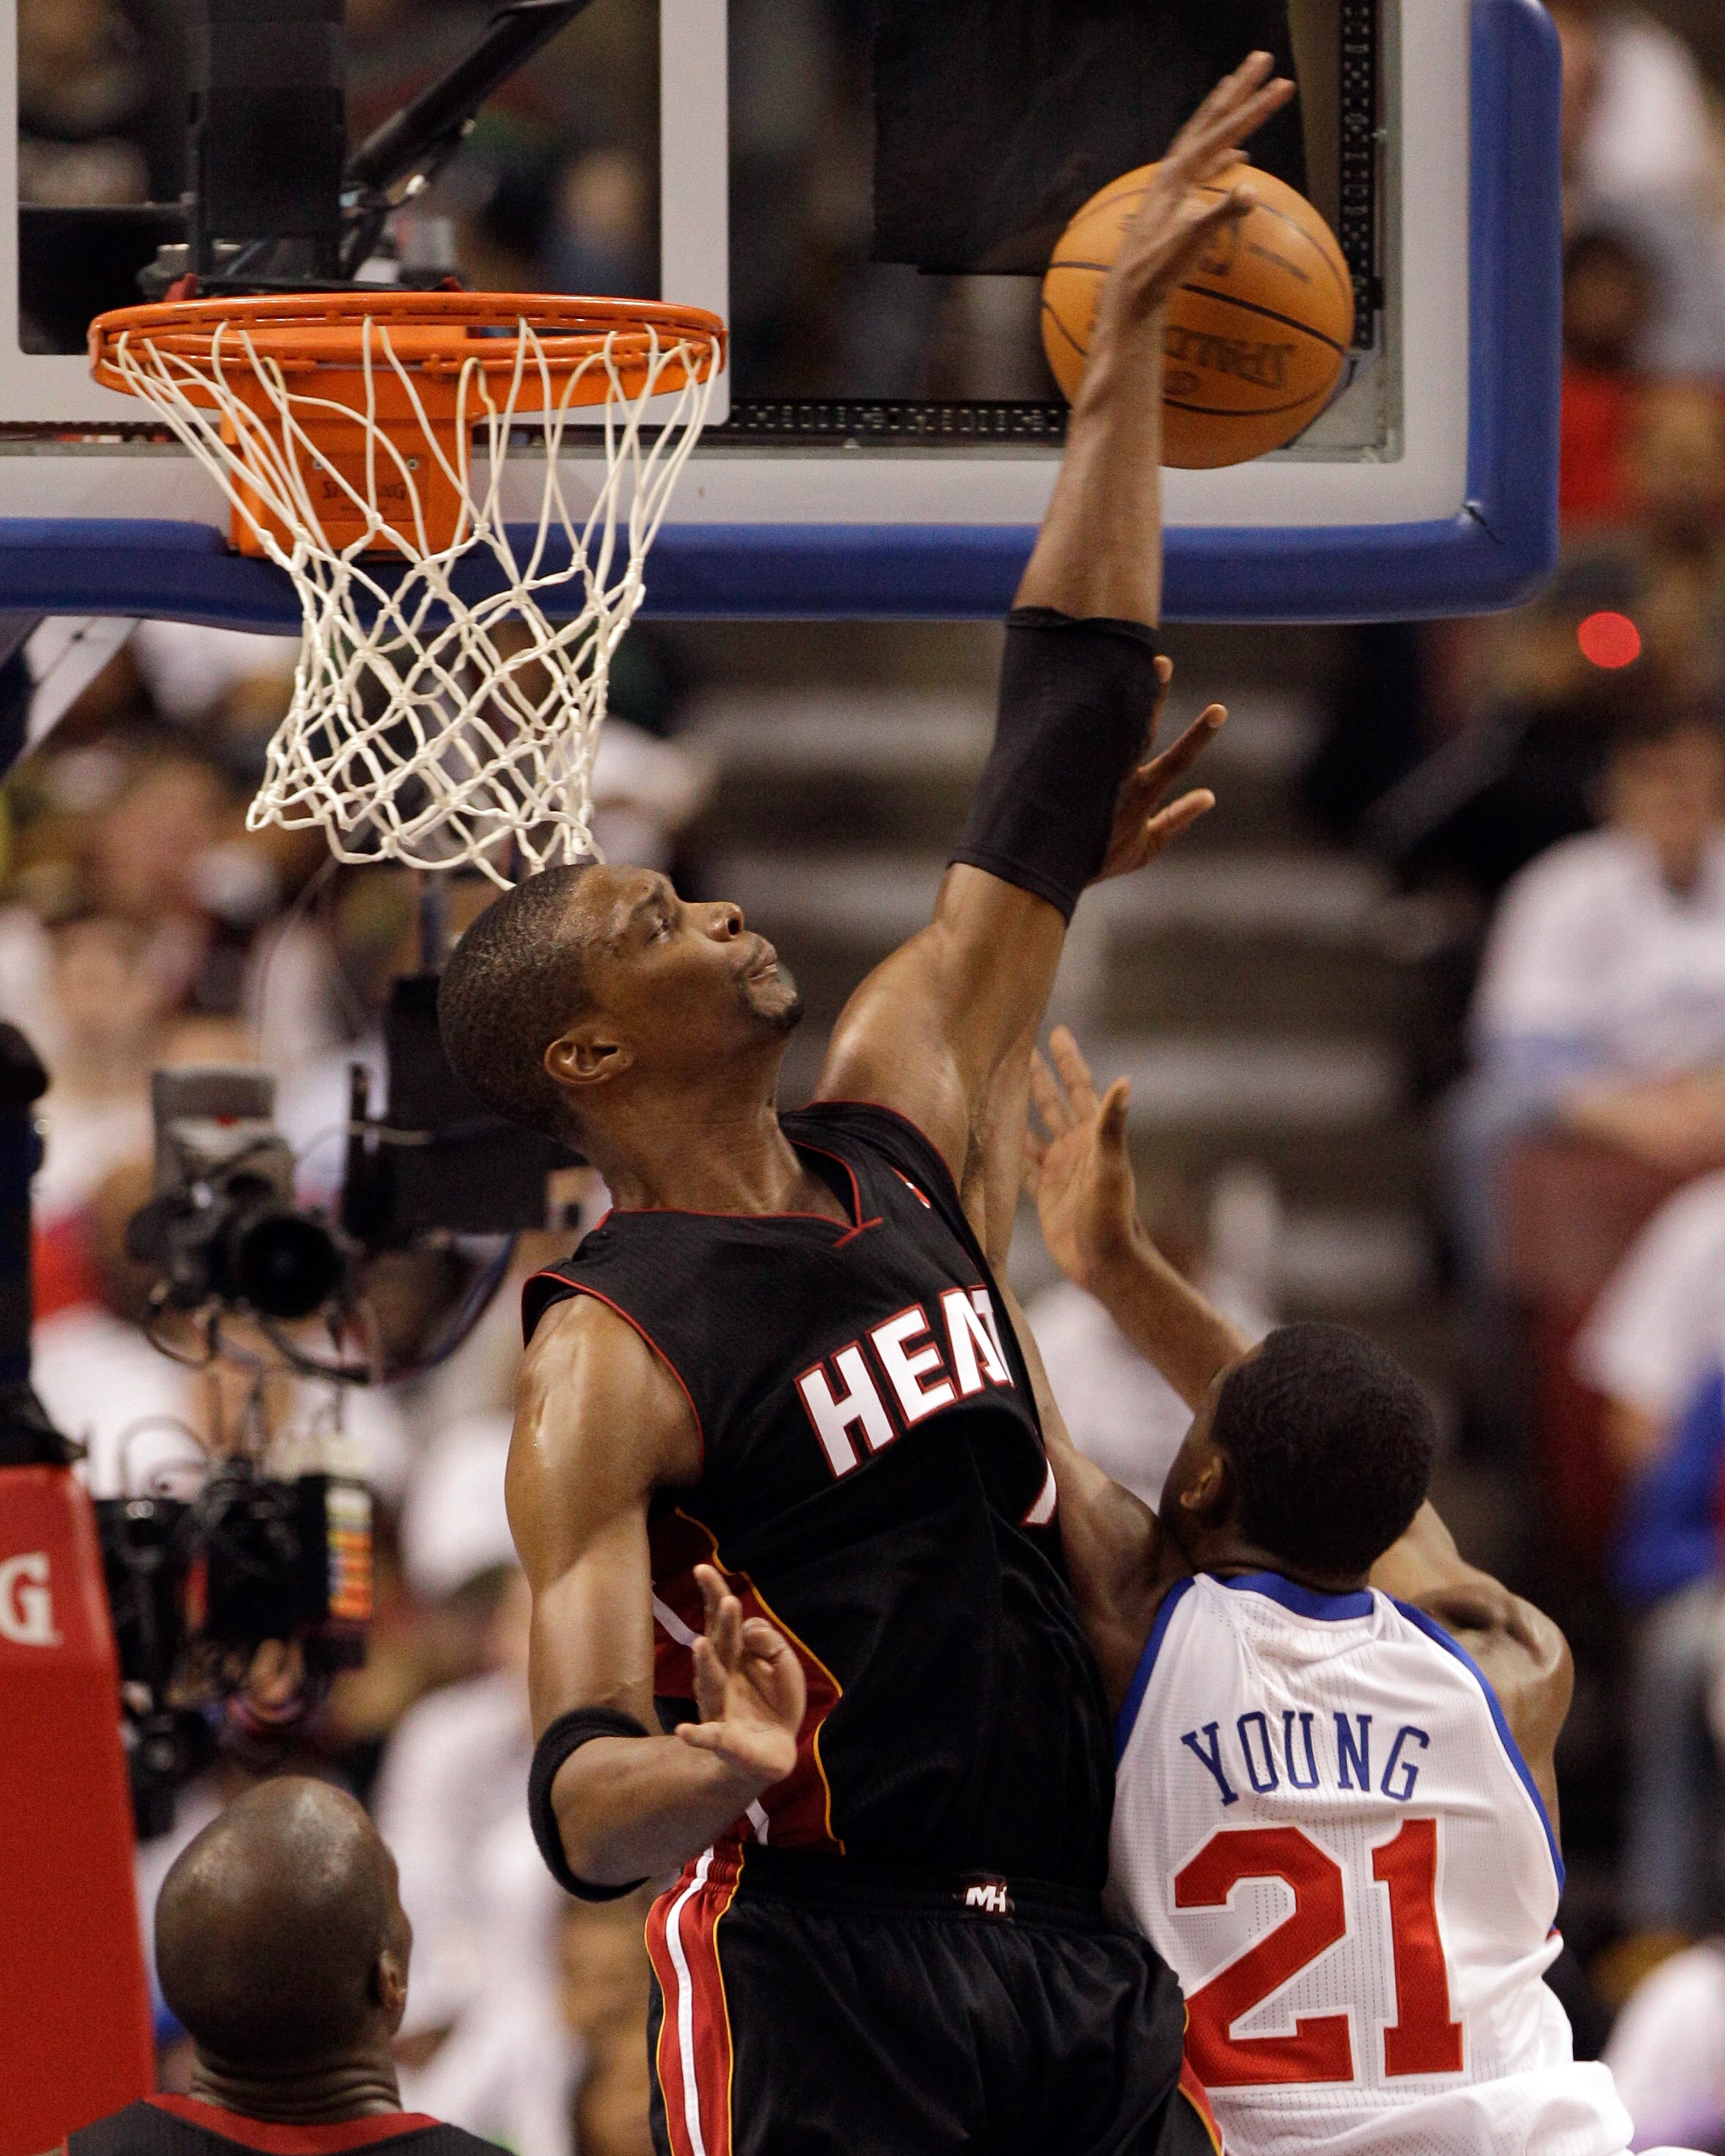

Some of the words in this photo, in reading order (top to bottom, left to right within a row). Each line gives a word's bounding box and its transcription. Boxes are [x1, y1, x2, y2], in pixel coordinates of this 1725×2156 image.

[0, 1551, 64, 1648] G
[1181, 1709, 1431, 1806] YOUNG
[965, 1885, 1007, 1913] MH
[1173, 1817, 1465, 2088] 21
